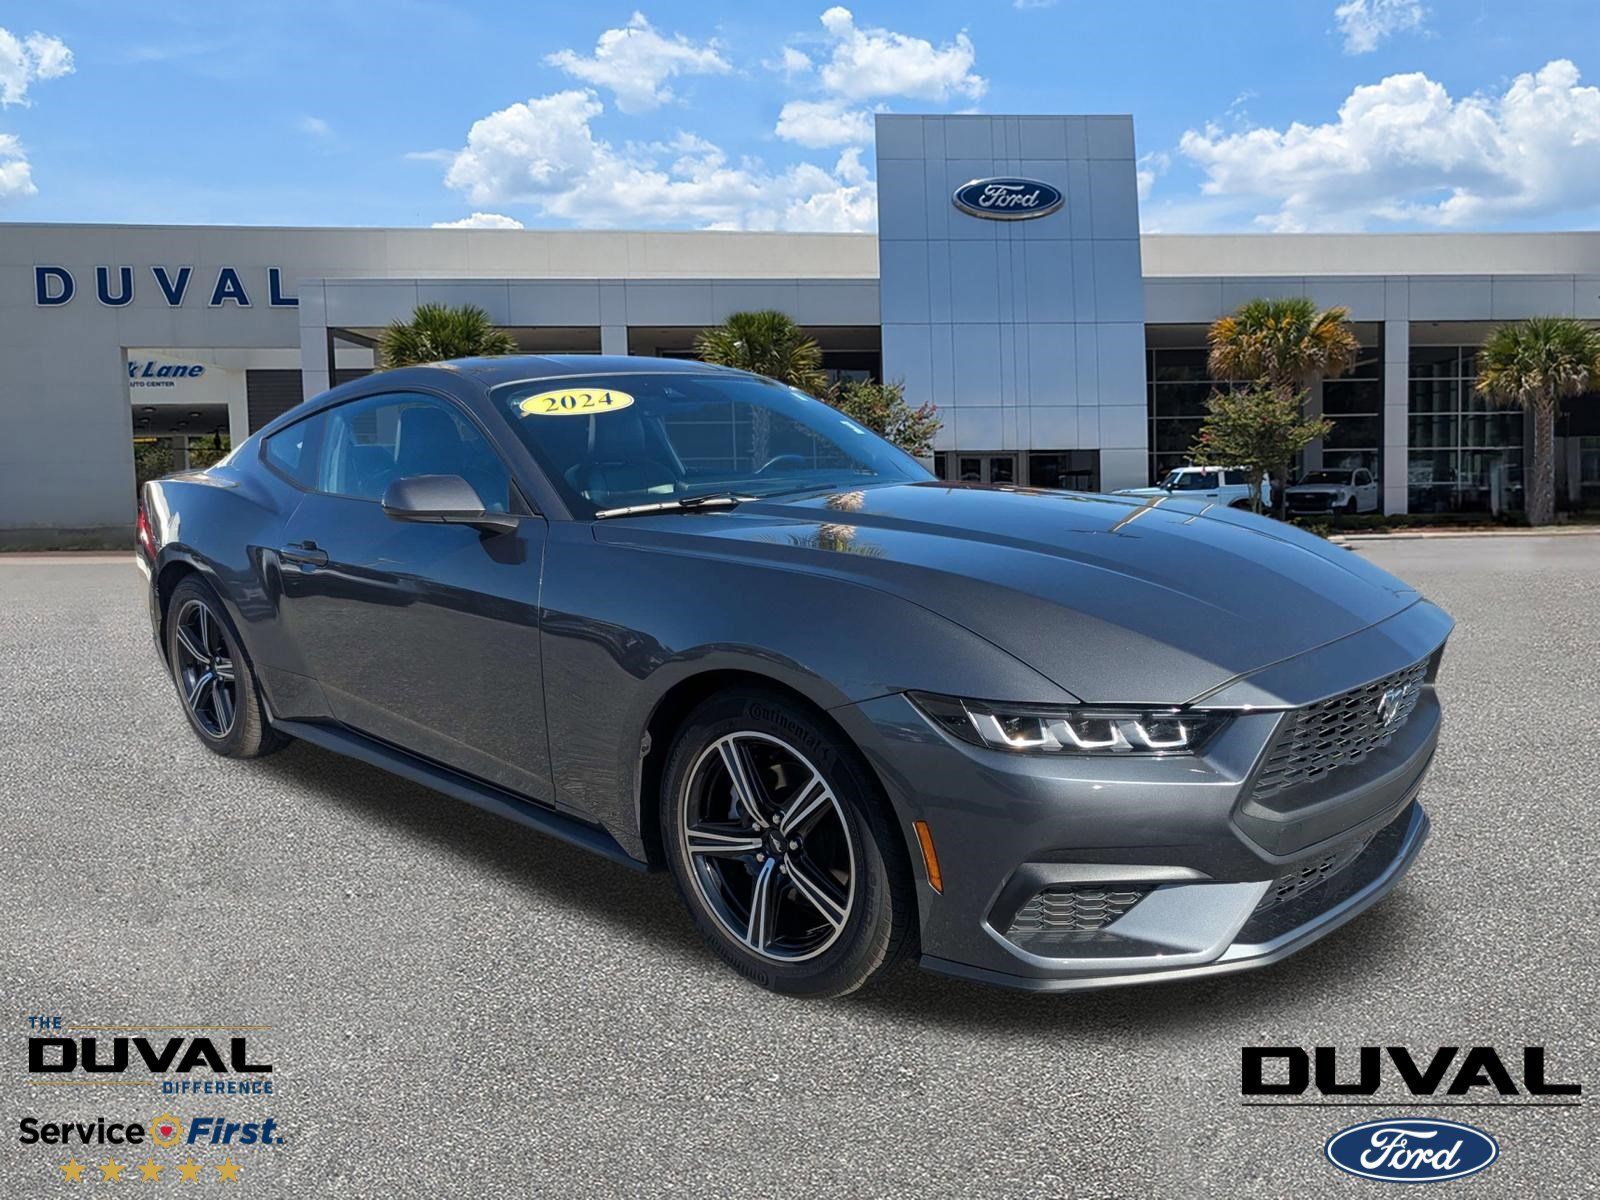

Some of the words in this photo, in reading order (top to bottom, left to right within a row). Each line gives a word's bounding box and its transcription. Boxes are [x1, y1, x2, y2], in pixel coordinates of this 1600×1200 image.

[978, 184, 1040, 207] Ford
[33, 265, 299, 308] DUVAL
[141, 361, 205, 378] Lane
[542, 392, 613, 412] 2024
[748, 703, 822, 753] Continental
